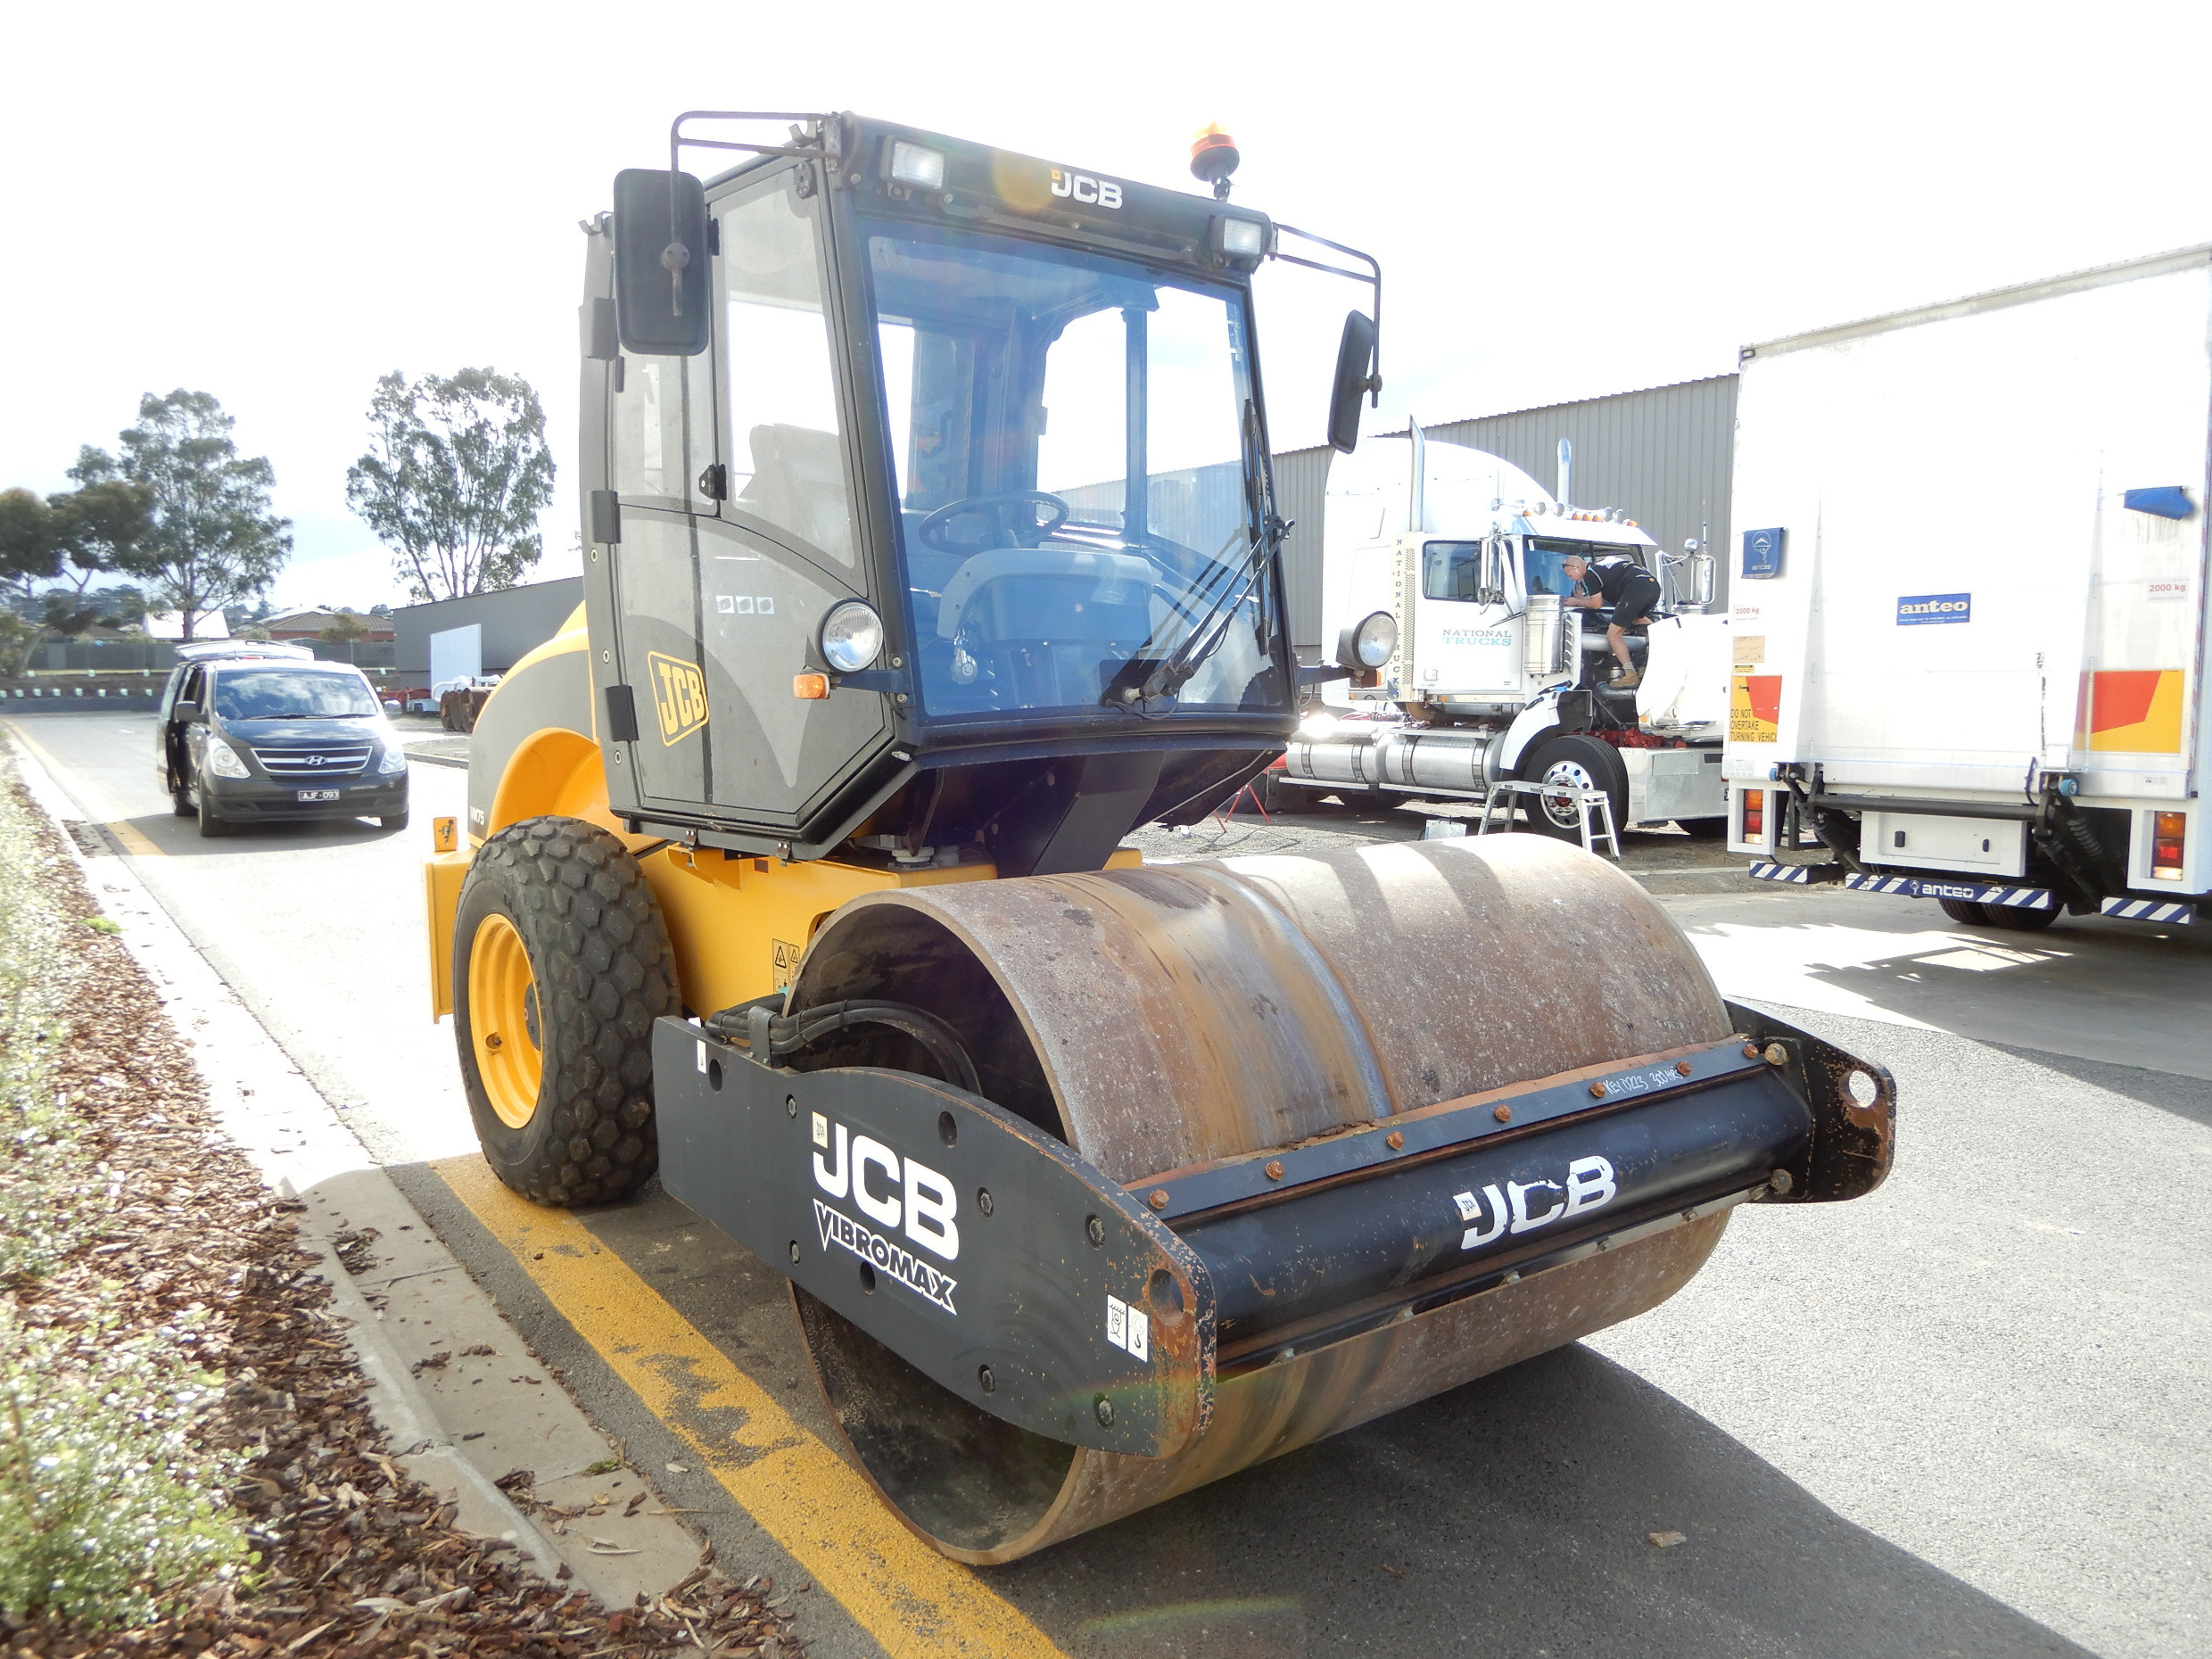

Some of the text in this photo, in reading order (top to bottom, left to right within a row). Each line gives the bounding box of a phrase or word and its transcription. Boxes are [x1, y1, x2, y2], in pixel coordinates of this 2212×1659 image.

[1051, 170, 1123, 210] JCB
[1395, 539, 1403, 618] NATIONAL
[2149, 583, 2186, 593] 2000 kg
[1899, 599, 1968, 615] anteo
[1442, 629, 1512, 638] NATIONAL
[1443, 637, 1512, 647] TRUCKS
[657, 661, 705, 736] JCB
[1730, 708, 1752, 718] DO NOT
[1730, 720, 1759, 730] OVERTAKE
[1730, 731, 1754, 742] TURNING
[1921, 883, 1975, 899] anteo
[813, 1121, 959, 1260] JCB
[1460, 1155, 1616, 1250] JCB
[813, 1198, 958, 1316] VIBROMAX
